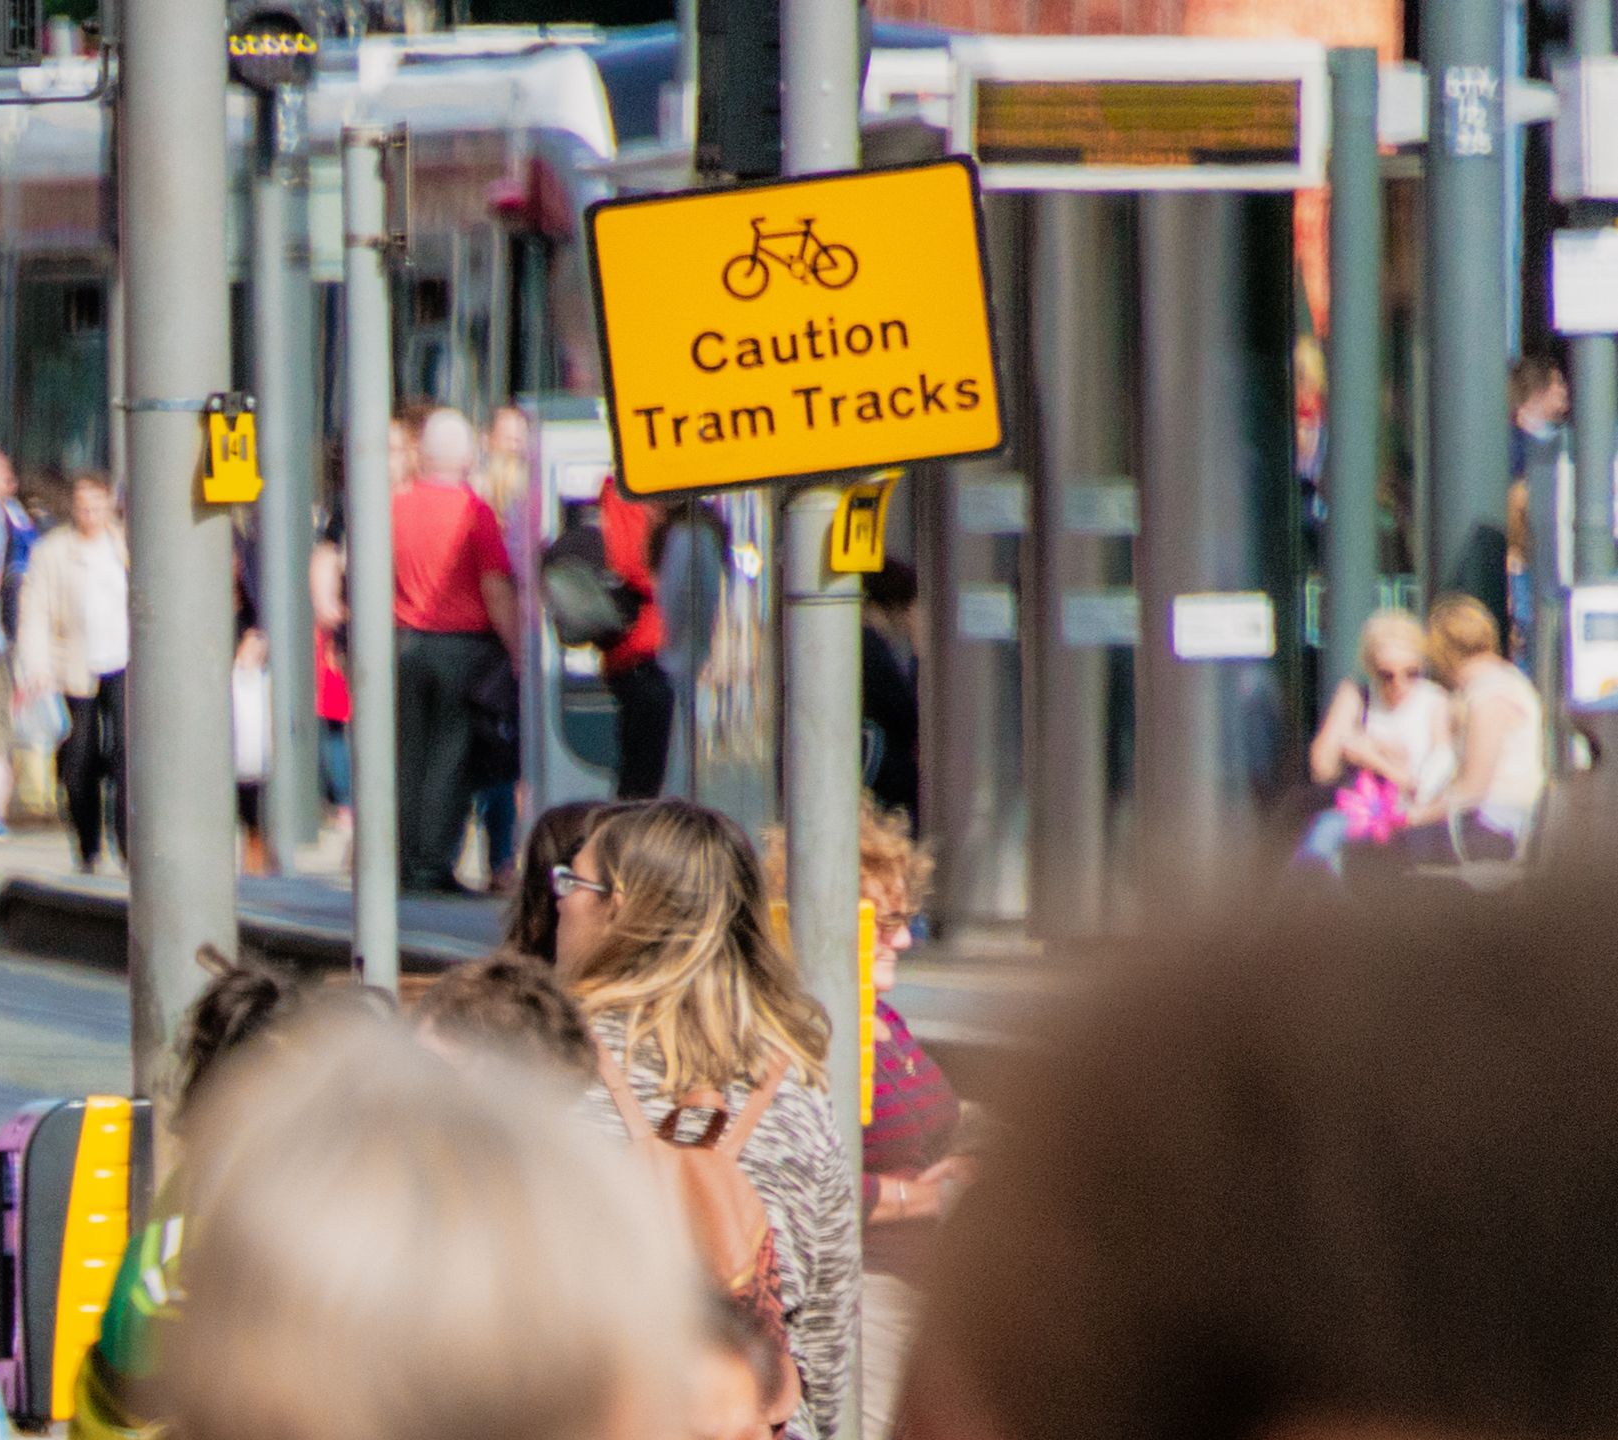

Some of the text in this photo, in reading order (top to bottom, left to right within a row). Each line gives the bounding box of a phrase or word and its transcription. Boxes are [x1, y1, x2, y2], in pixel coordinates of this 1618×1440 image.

[690, 315, 910, 374] Caution
[632, 373, 982, 451] Tram Tracks
